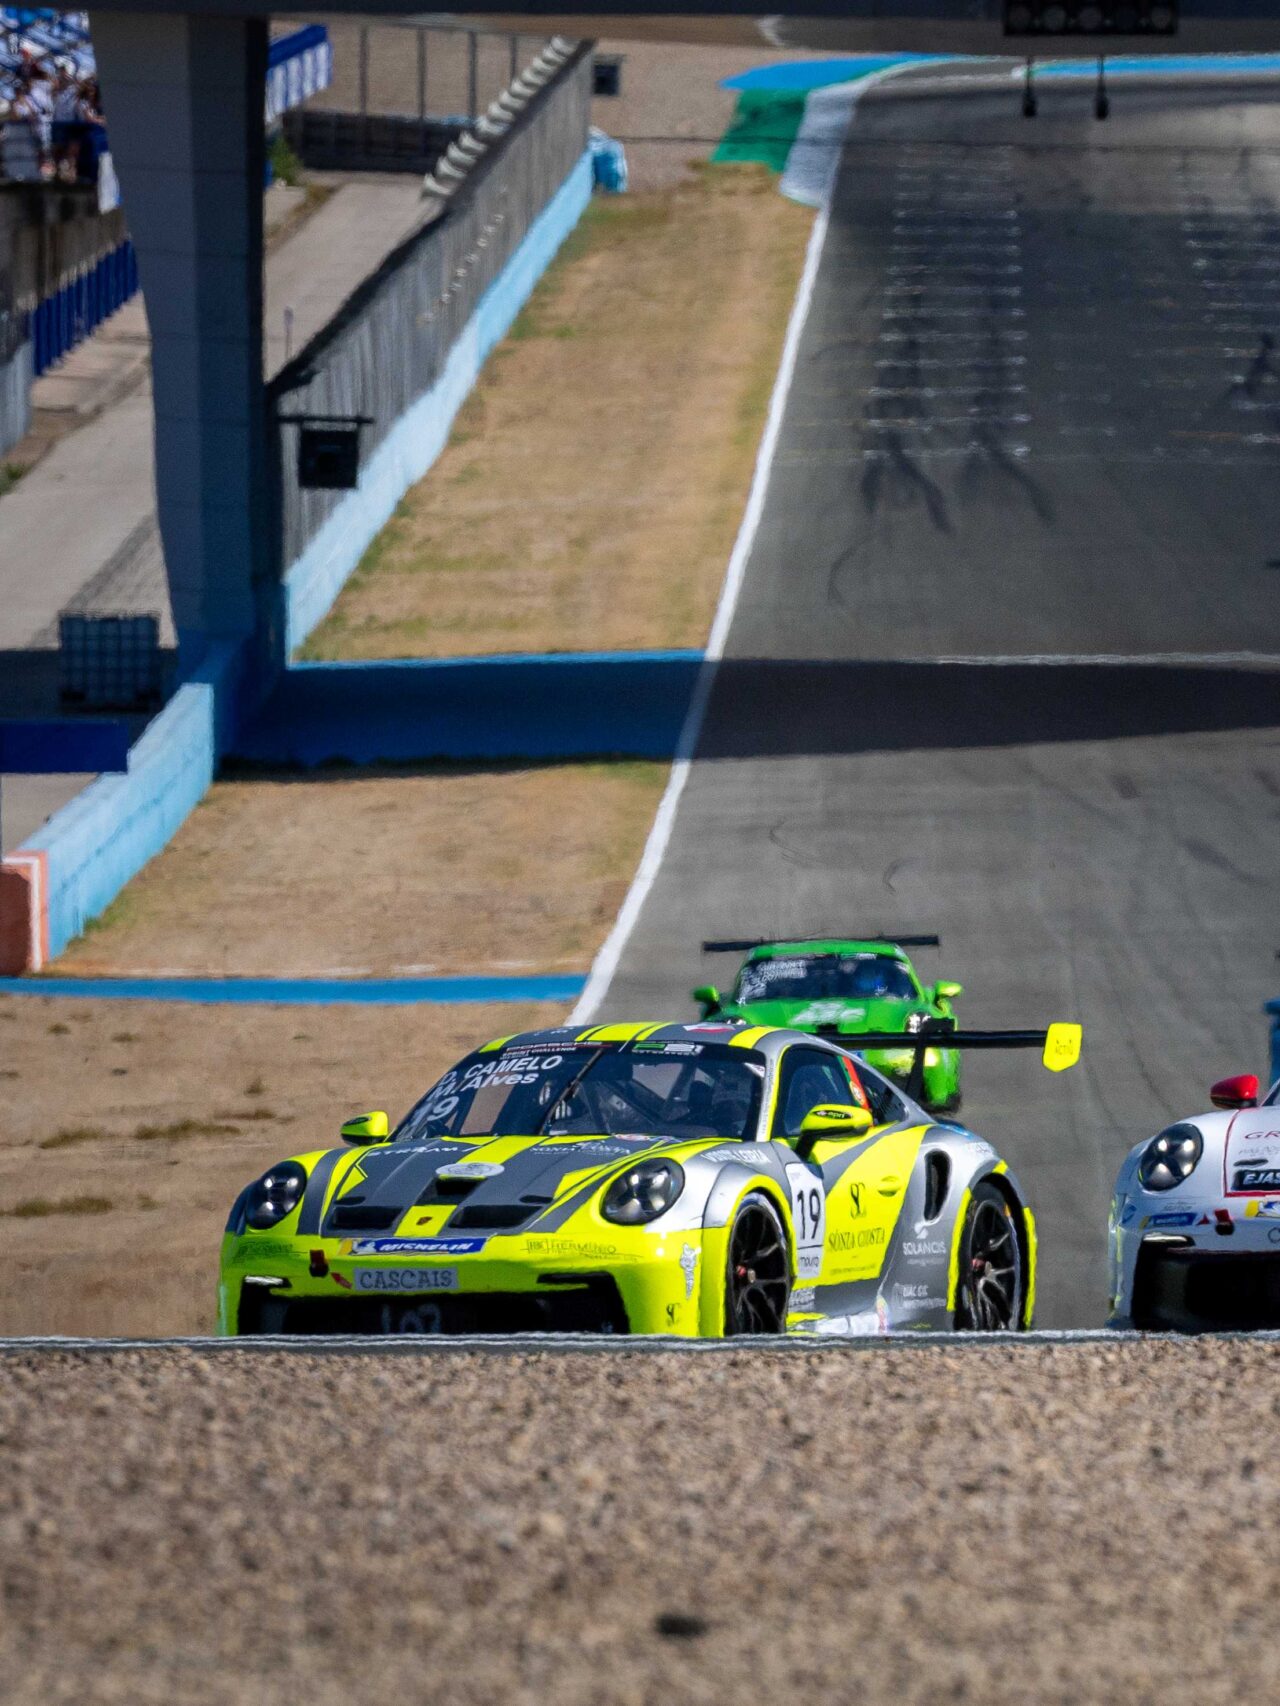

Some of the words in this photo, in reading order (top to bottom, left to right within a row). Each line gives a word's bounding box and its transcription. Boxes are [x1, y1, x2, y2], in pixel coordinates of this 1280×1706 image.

[464, 1055, 563, 1079] CAMELO
[460, 1072, 540, 1092] Alves
[797, 1187, 821, 1241] 19
[379, 1240, 475, 1252] MICHELIN
[359, 1267, 453, 1289] CASCAIS
